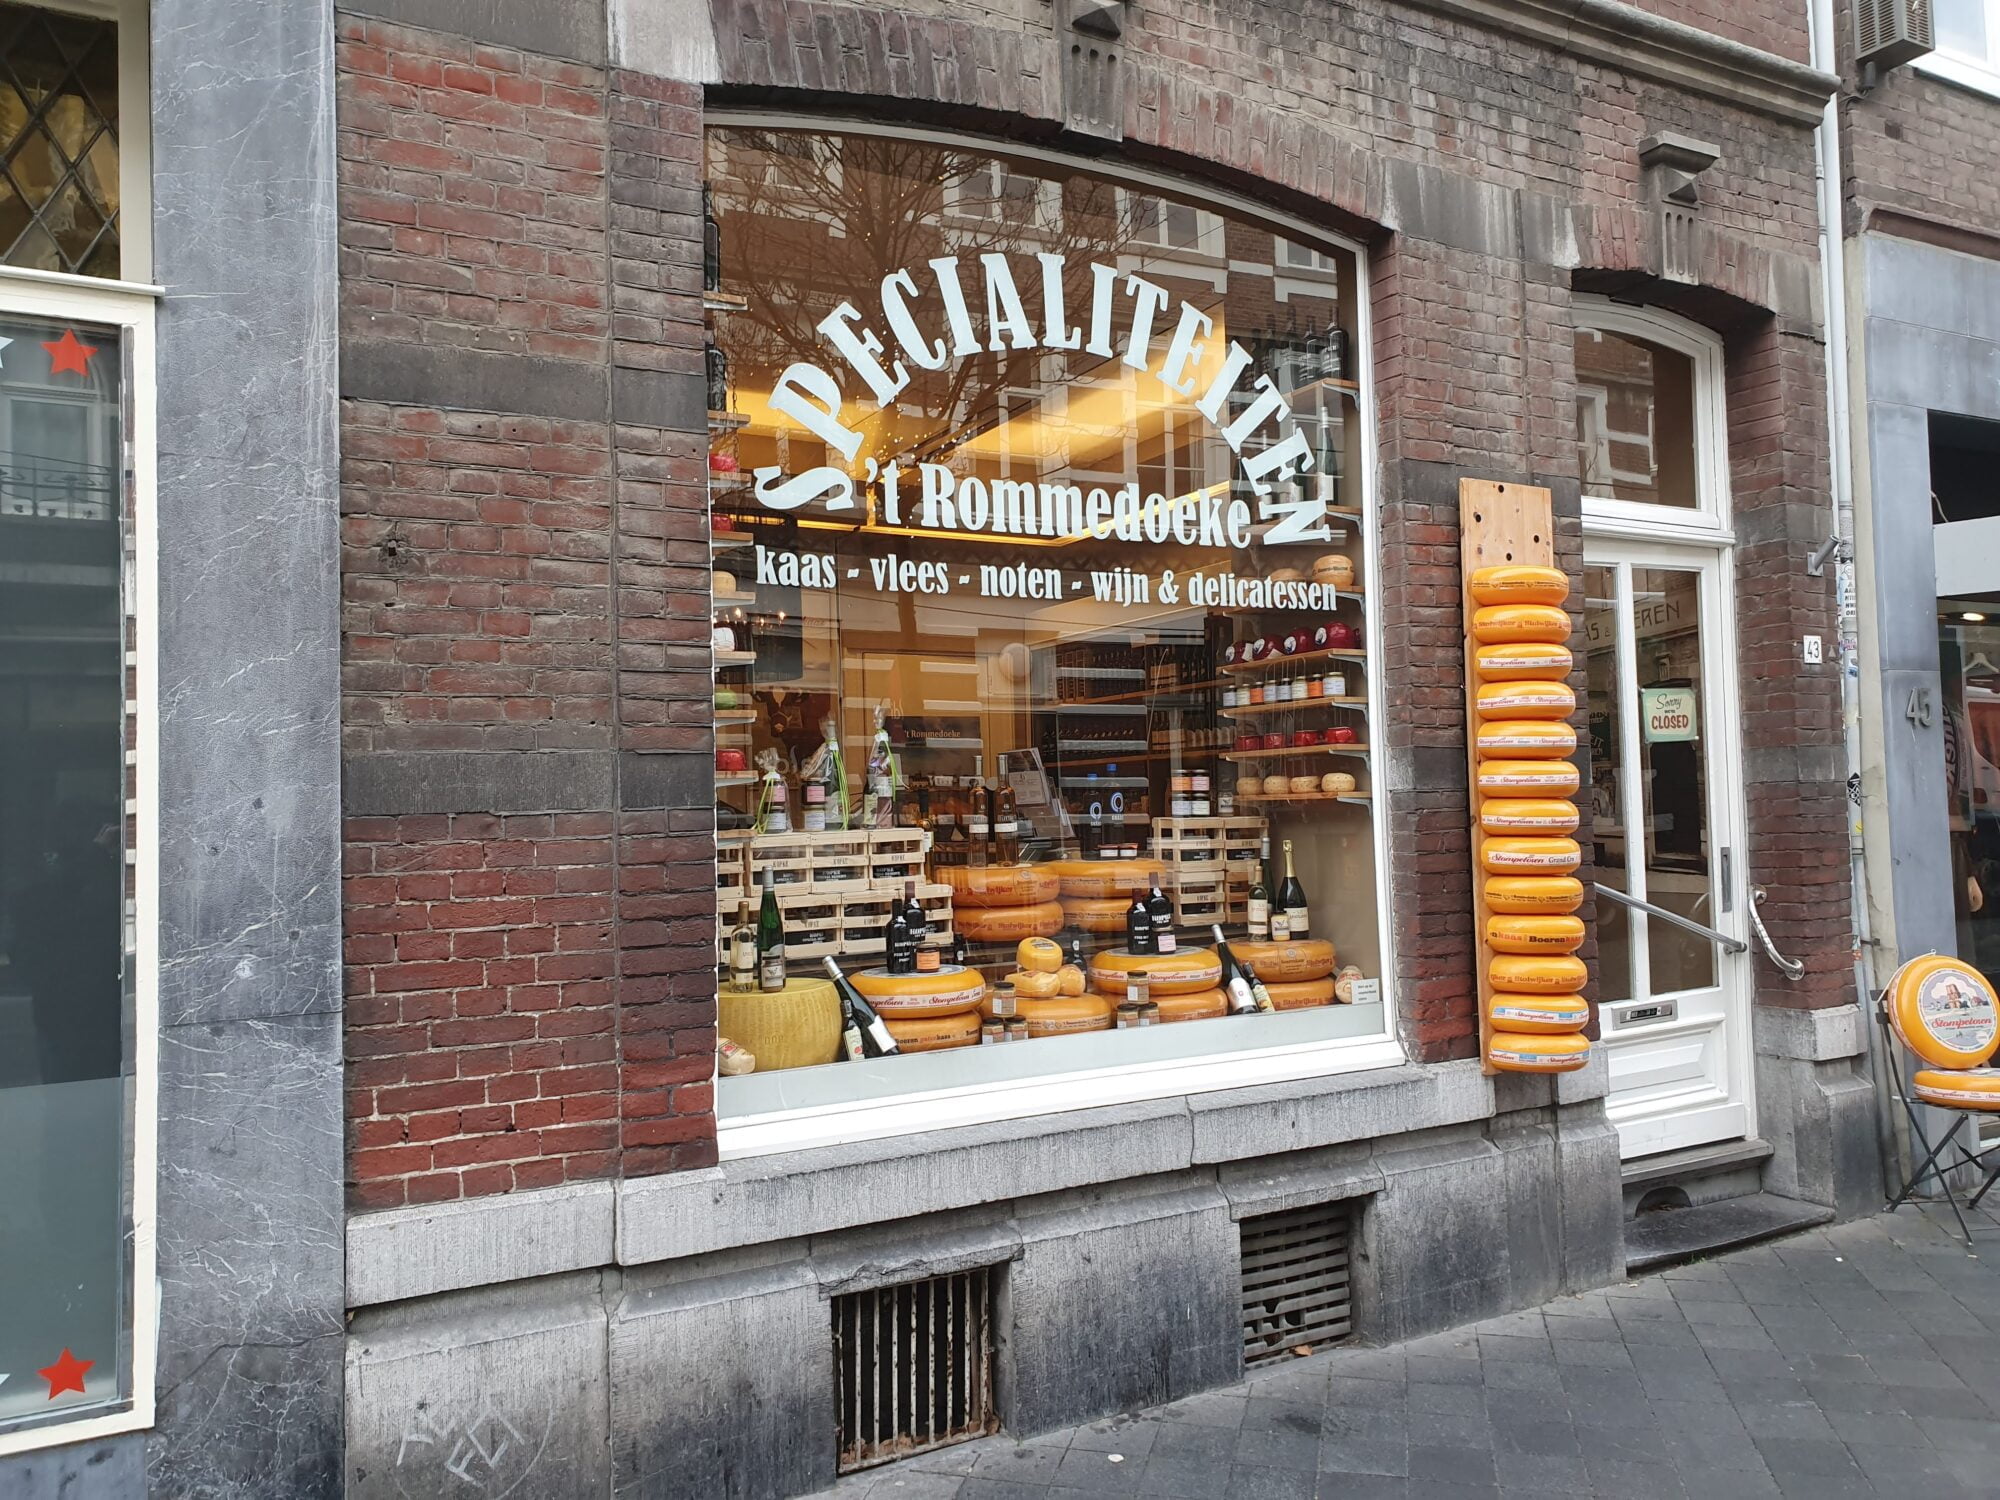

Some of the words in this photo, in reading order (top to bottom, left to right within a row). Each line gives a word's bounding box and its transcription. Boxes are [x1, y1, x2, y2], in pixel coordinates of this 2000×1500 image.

[753, 253, 1331, 545] SPECIALITEITEN
[865, 457, 901, 524] 't
[919, 463, 1251, 548] Rommedoeke
[755, 545, 836, 588] kaas
[869, 554, 949, 594] vlees
[980, 562, 1062, 600] noten
[1091, 567, 1149, 607] wijn
[1158, 570, 1179, 605] &
[1188, 572, 1337, 611] delicatessen
[1807, 639, 1820, 659] 43
[1651, 714, 1689, 730] CLOSED
[1655, 693, 1682, 710] Sorry
[1906, 686, 1931, 728] 45
